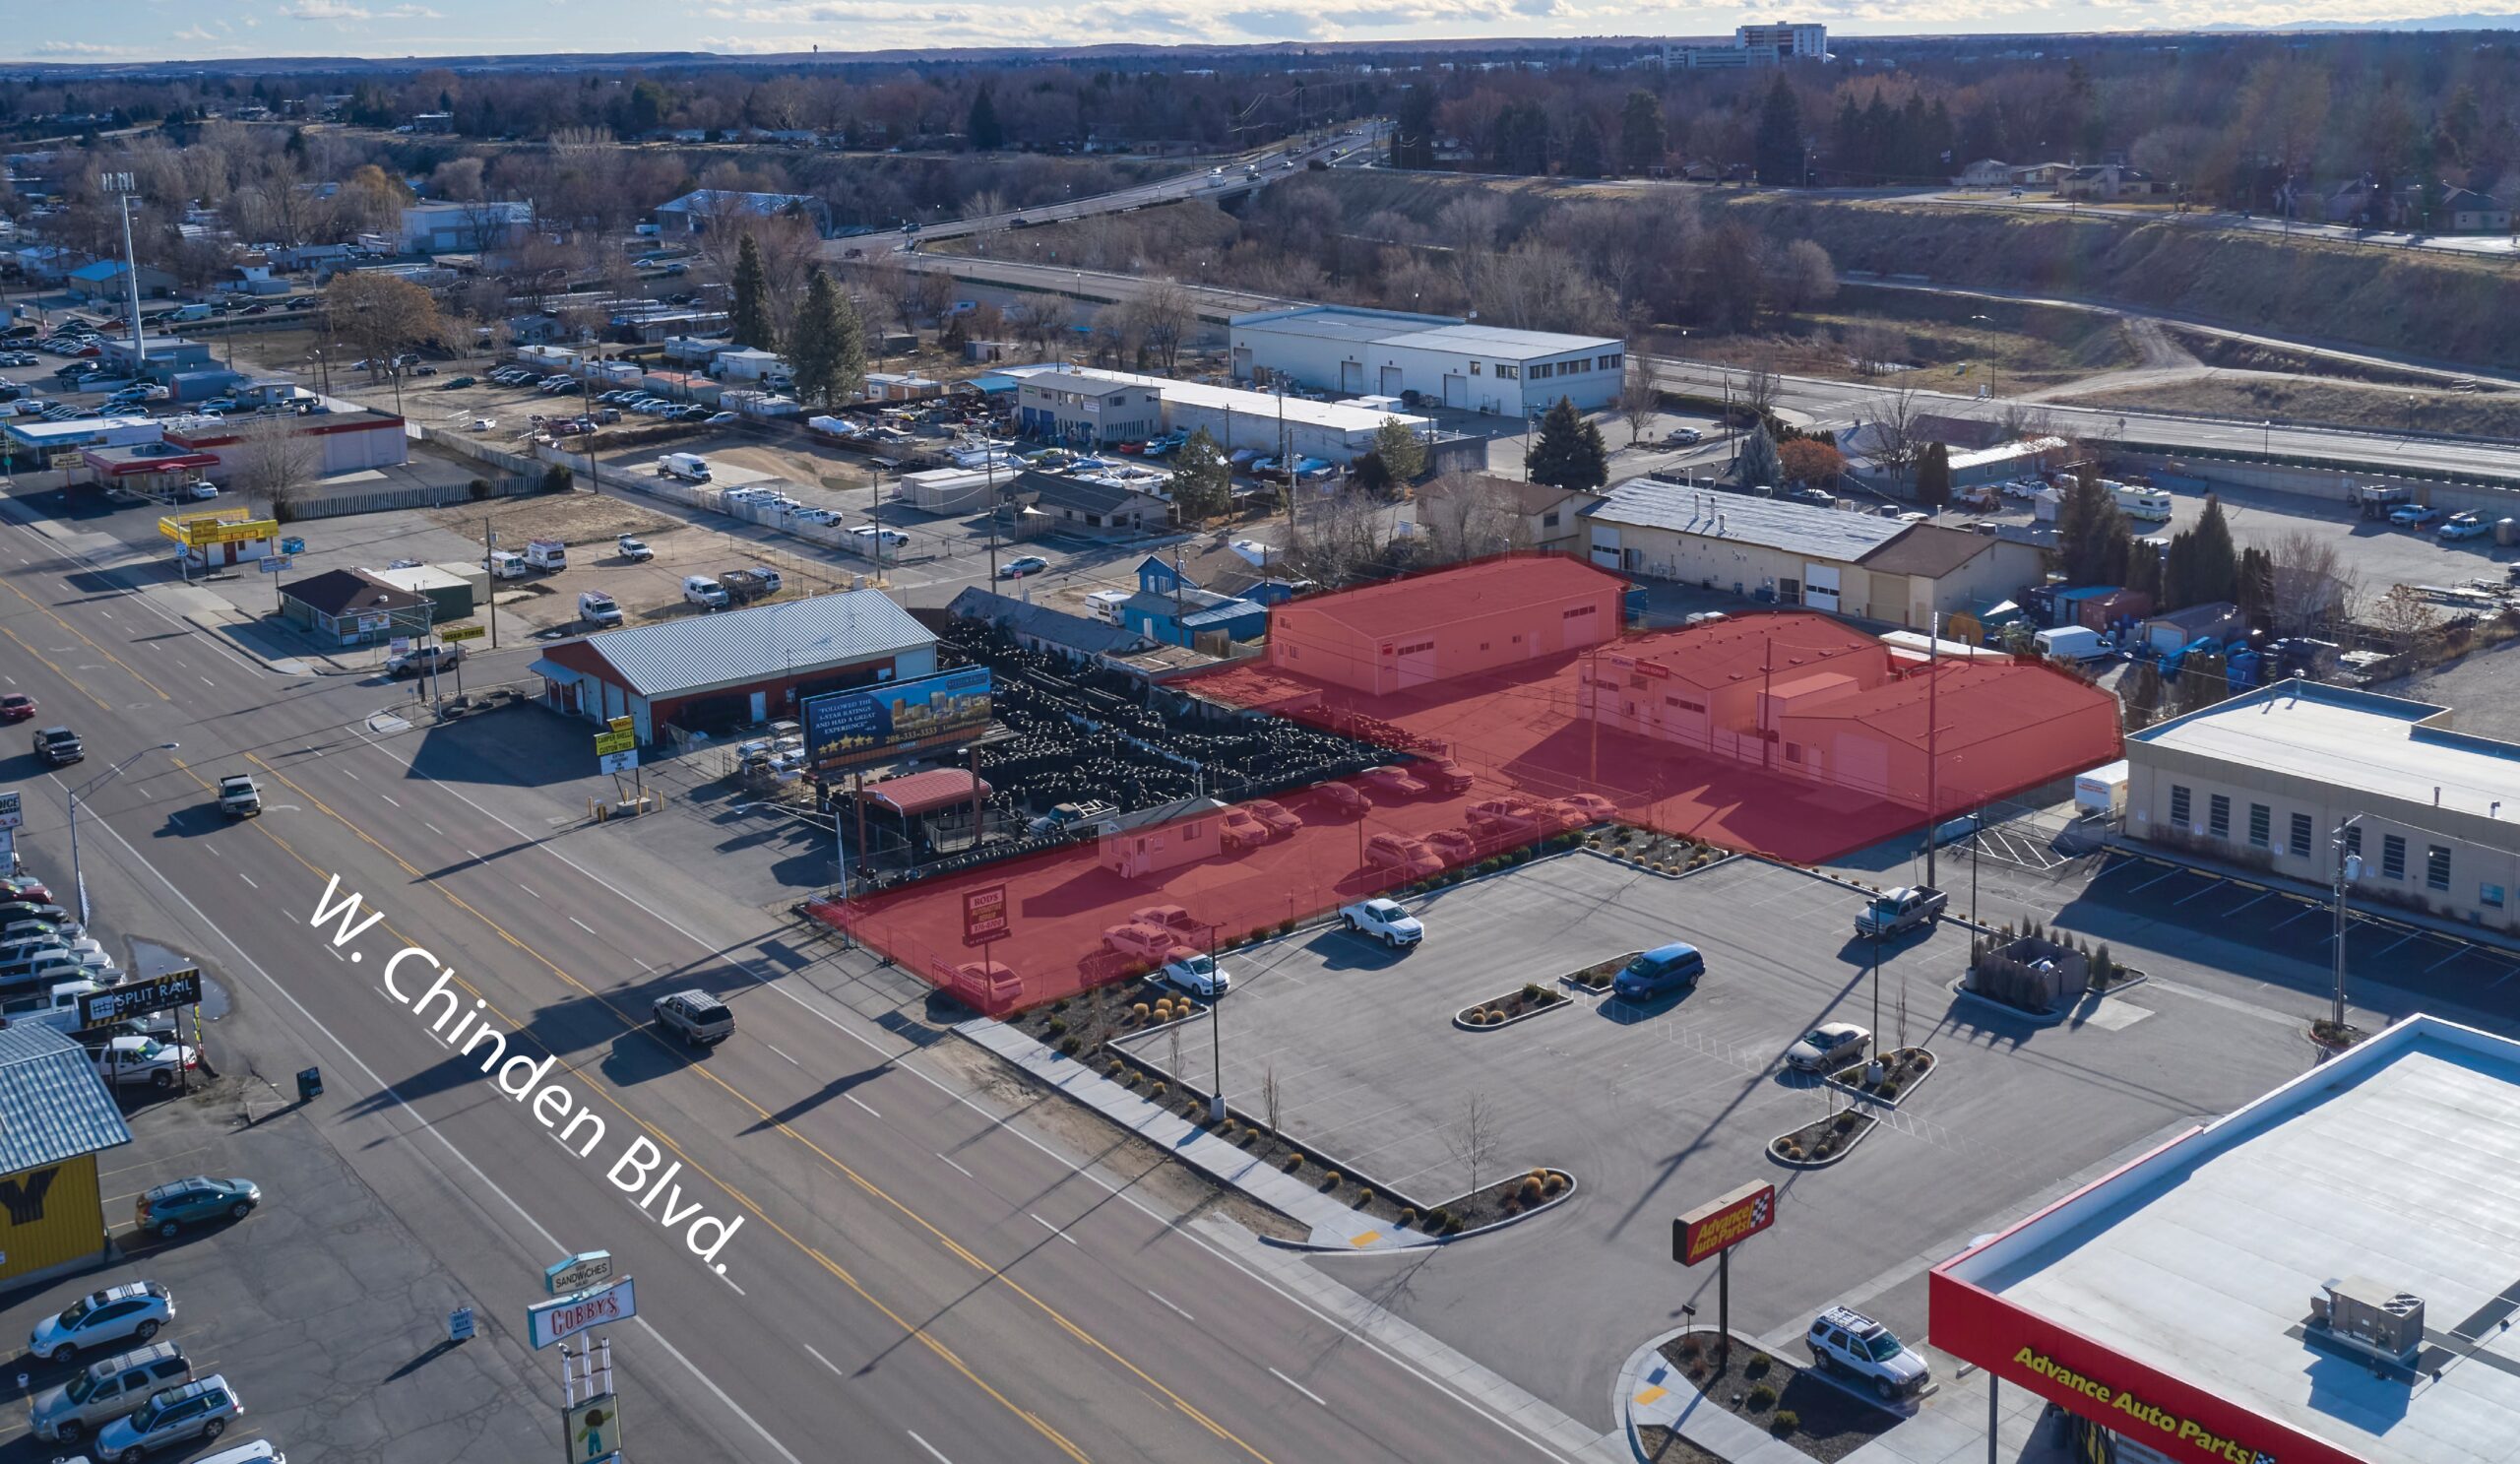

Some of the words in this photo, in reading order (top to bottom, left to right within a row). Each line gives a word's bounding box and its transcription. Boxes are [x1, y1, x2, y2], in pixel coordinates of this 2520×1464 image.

[815, 720, 830, 729] AND
[832, 717, 847, 726] HAD
[853, 712, 876, 722] GREAT
[843, 706, 871, 716] RATINGS
[598, 732, 615, 743] CAMPER
[616, 730, 633, 740] SHELLS
[599, 744, 618, 754] CUSTOM
[116, 987, 154, 1007] SPLIT
[159, 980, 193, 997] RAIL
[1697, 1205, 1750, 1241] Advance
[1690, 1236, 1718, 1259] Auto
[1718, 1219, 1748, 1244] Parts
[551, 1292, 620, 1337] COBBY'S
[2013, 1347, 2111, 1403] Advance
[2111, 1392, 2176, 1432] Auto
[2177, 1420, 2250, 1464] Parts
